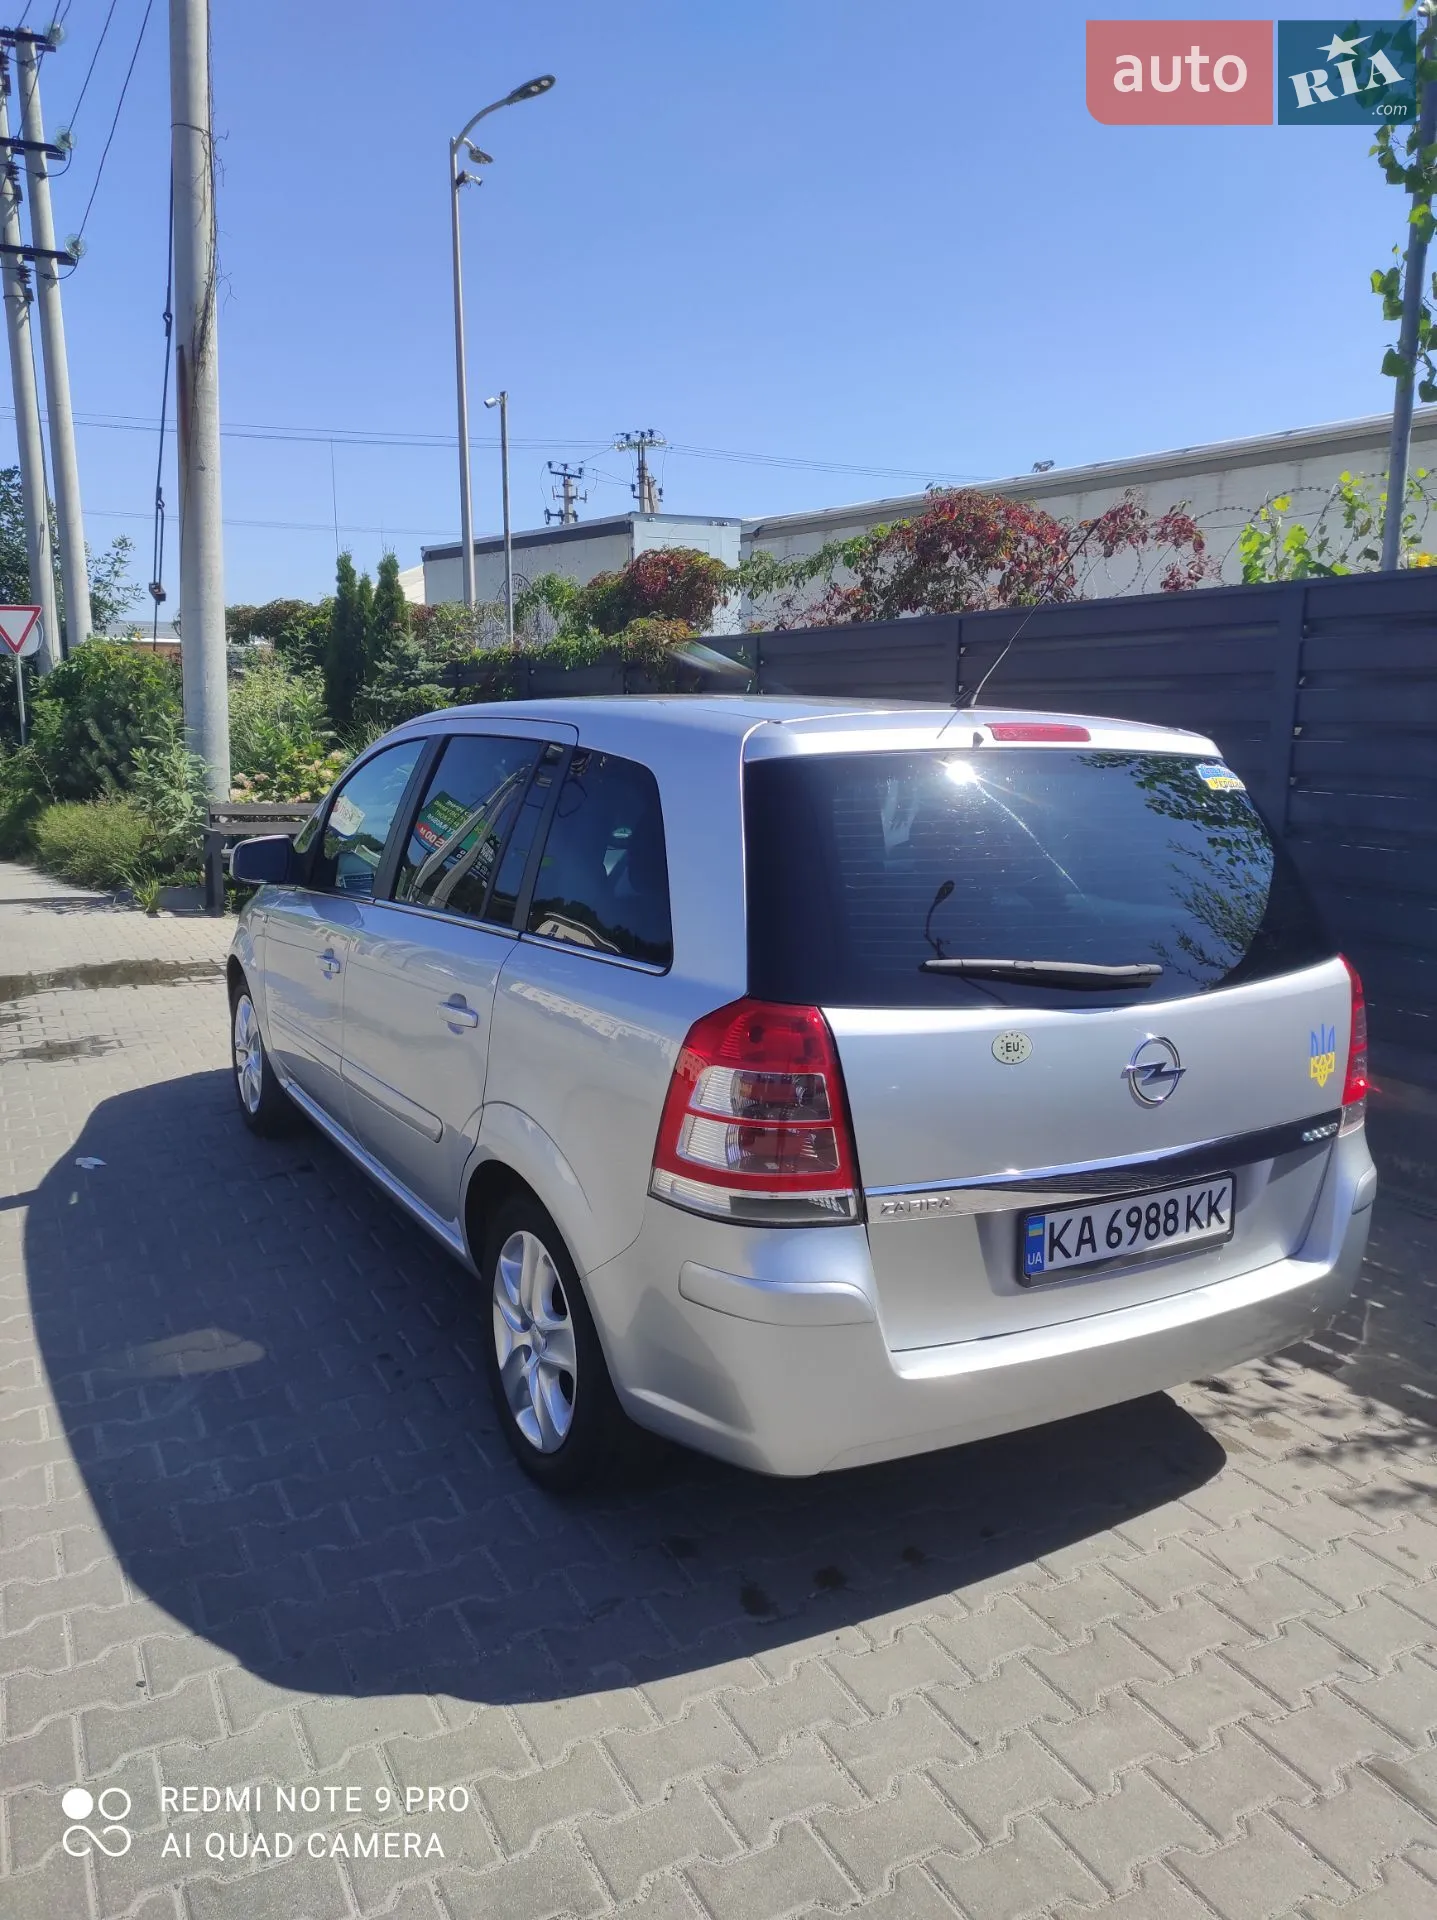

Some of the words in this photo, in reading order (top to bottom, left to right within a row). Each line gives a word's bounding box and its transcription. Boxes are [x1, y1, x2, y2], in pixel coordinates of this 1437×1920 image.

[1005, 1041, 1020, 1053] EU
[880, 1196, 953, 1215] ZAFIRA
[1027, 1251, 1043, 1266] UA
